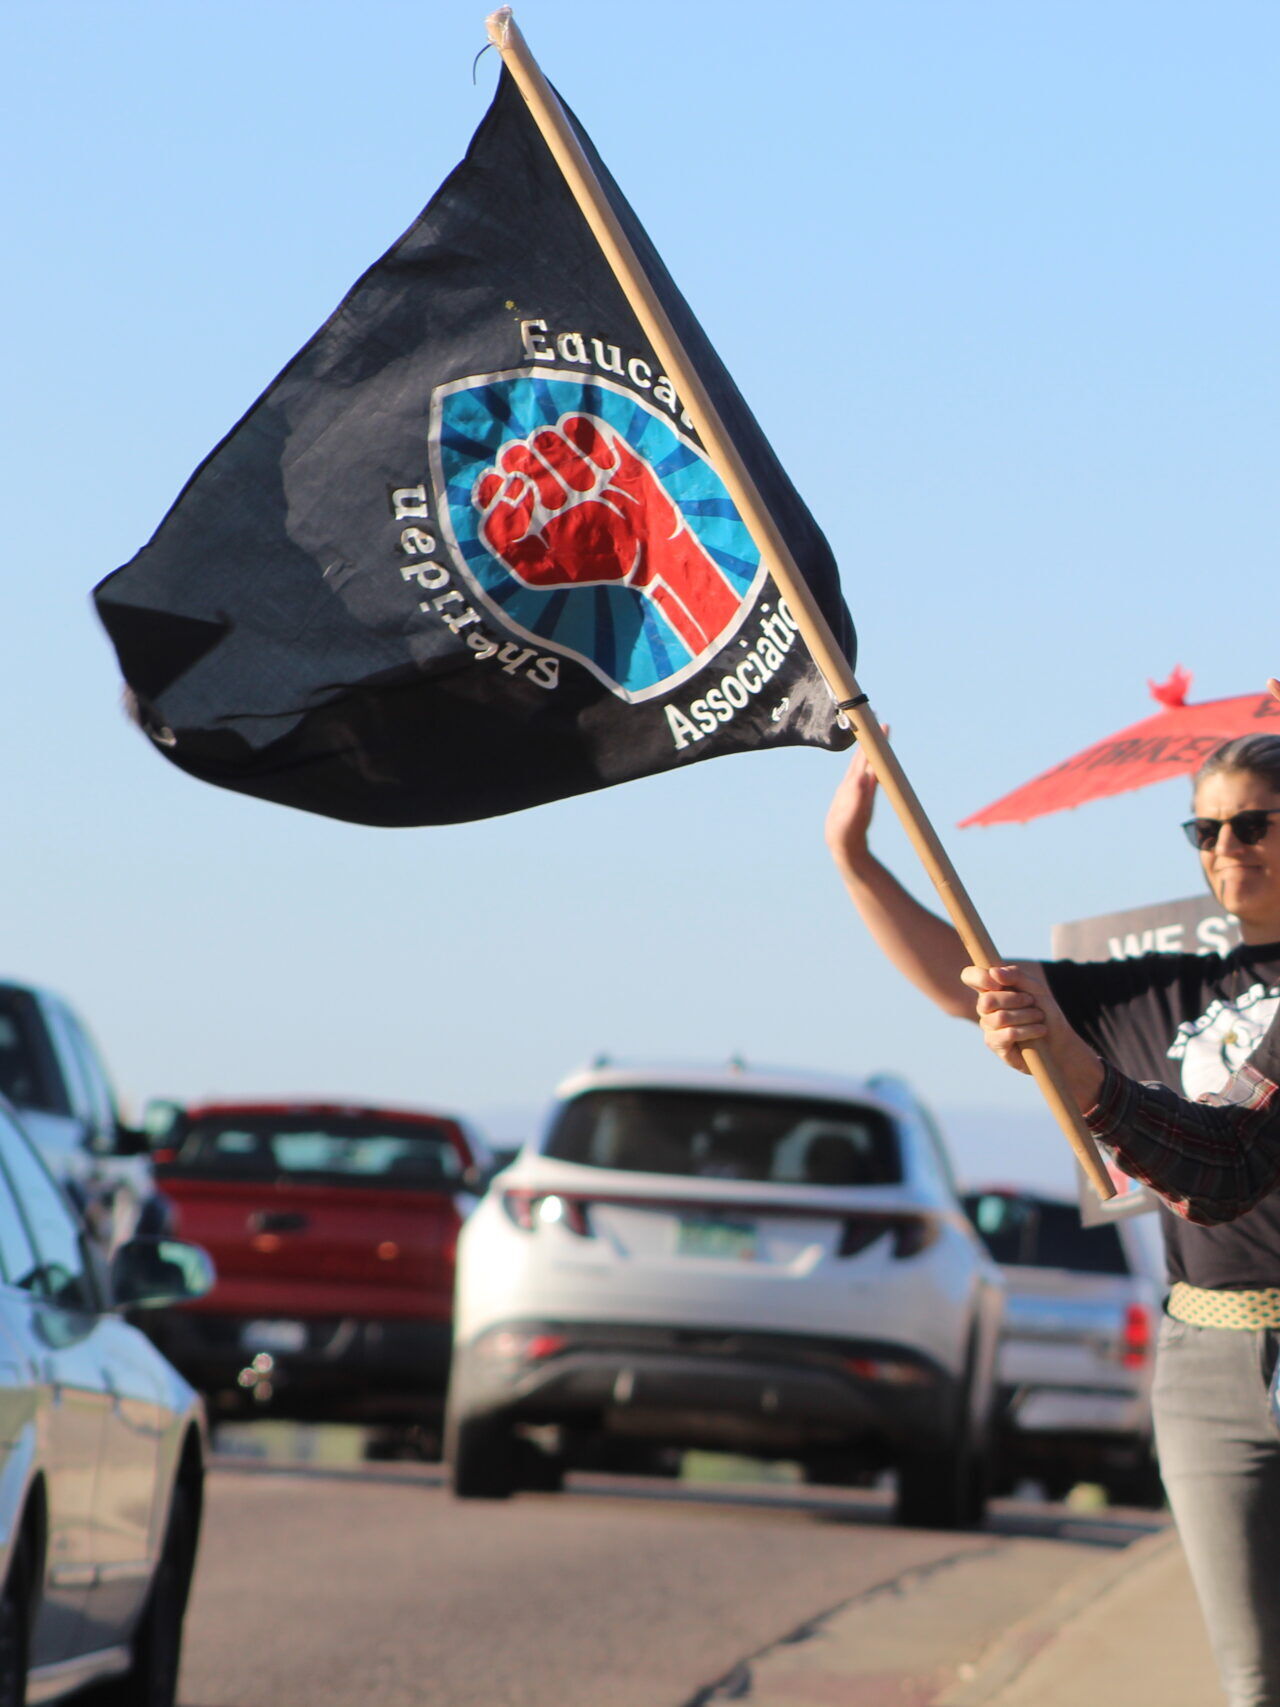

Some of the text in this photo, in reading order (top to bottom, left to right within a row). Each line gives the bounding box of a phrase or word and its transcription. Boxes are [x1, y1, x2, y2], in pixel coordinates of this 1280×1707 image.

[520, 319, 696, 429] Educa
[392, 484, 560, 690] Sheridan
[664, 596, 799, 750] Associatio
[1108, 924, 1183, 961] WE
